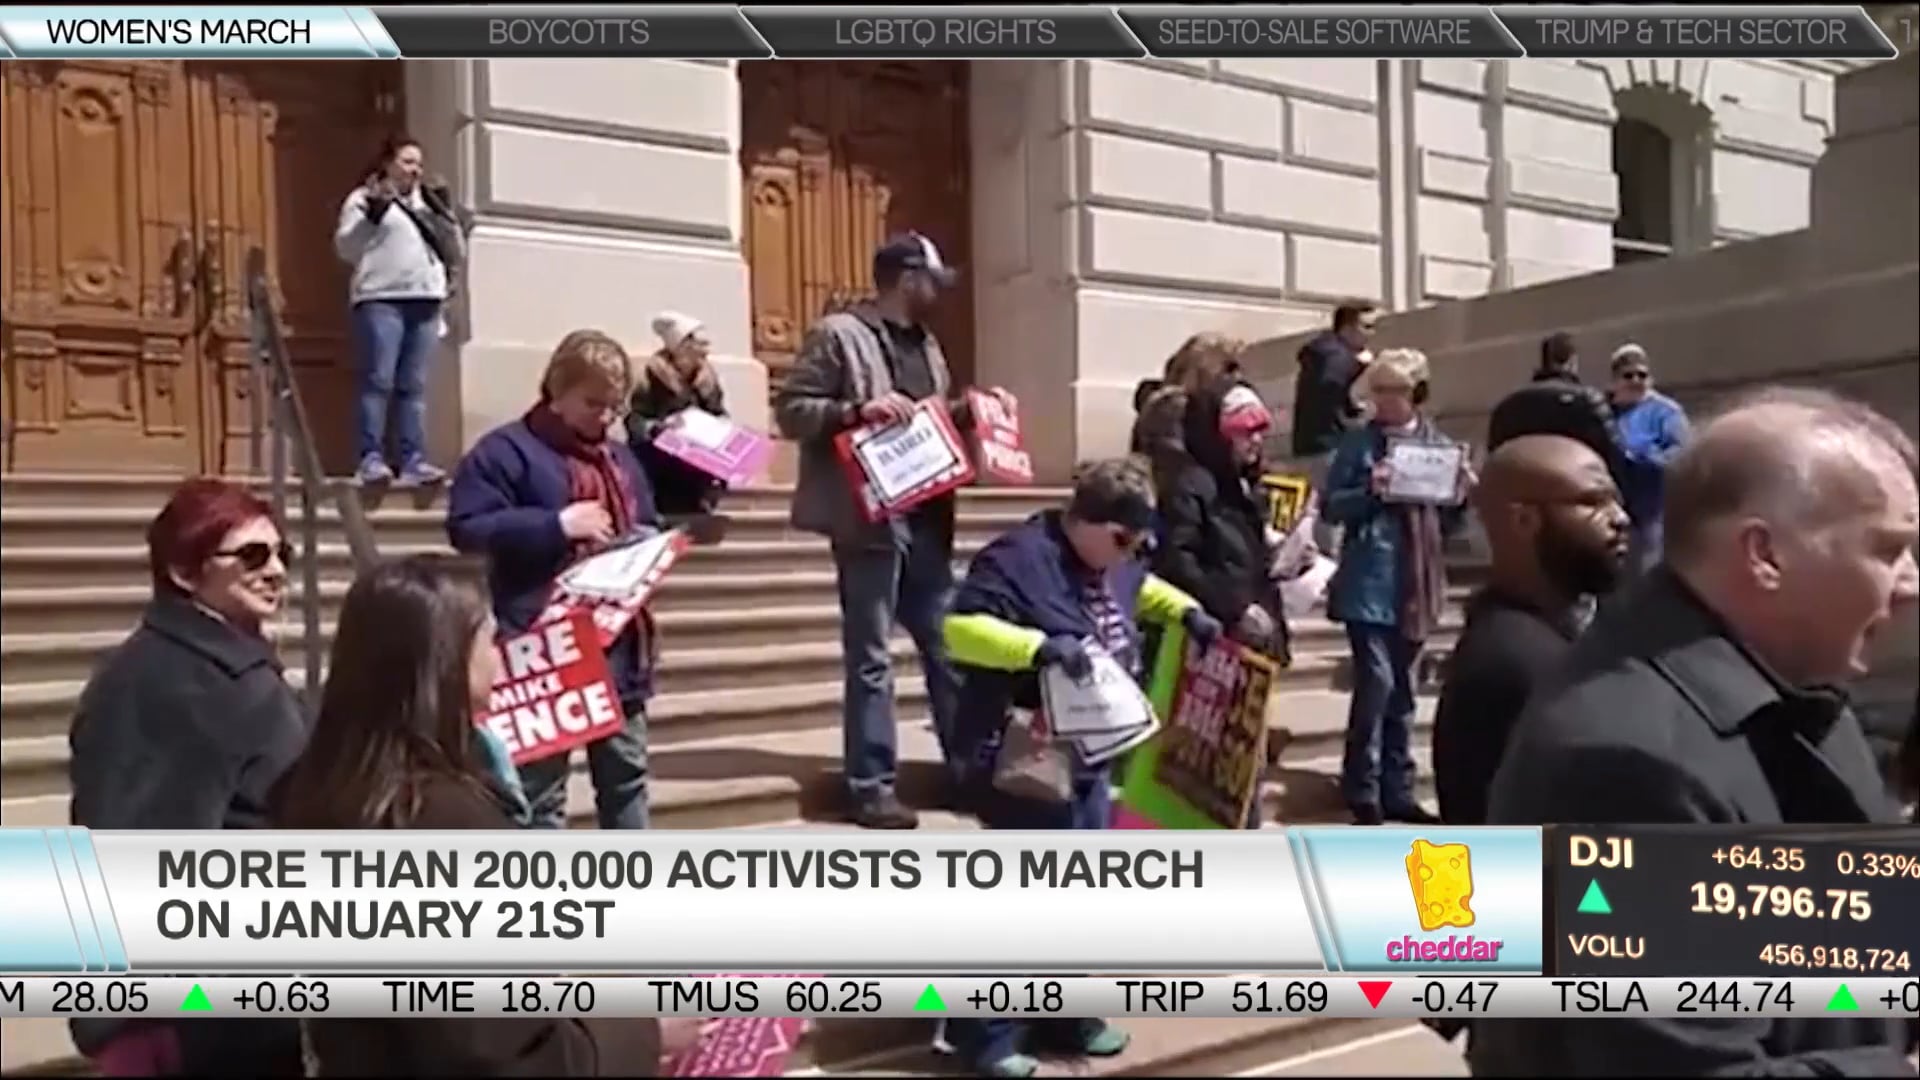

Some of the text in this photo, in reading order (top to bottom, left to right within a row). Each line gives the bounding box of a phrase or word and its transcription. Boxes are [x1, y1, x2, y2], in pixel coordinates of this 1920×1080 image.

[499, 620, 582, 680] RE
[486, 682, 618, 755] ENCE
[490, 672, 563, 711] MIKE
